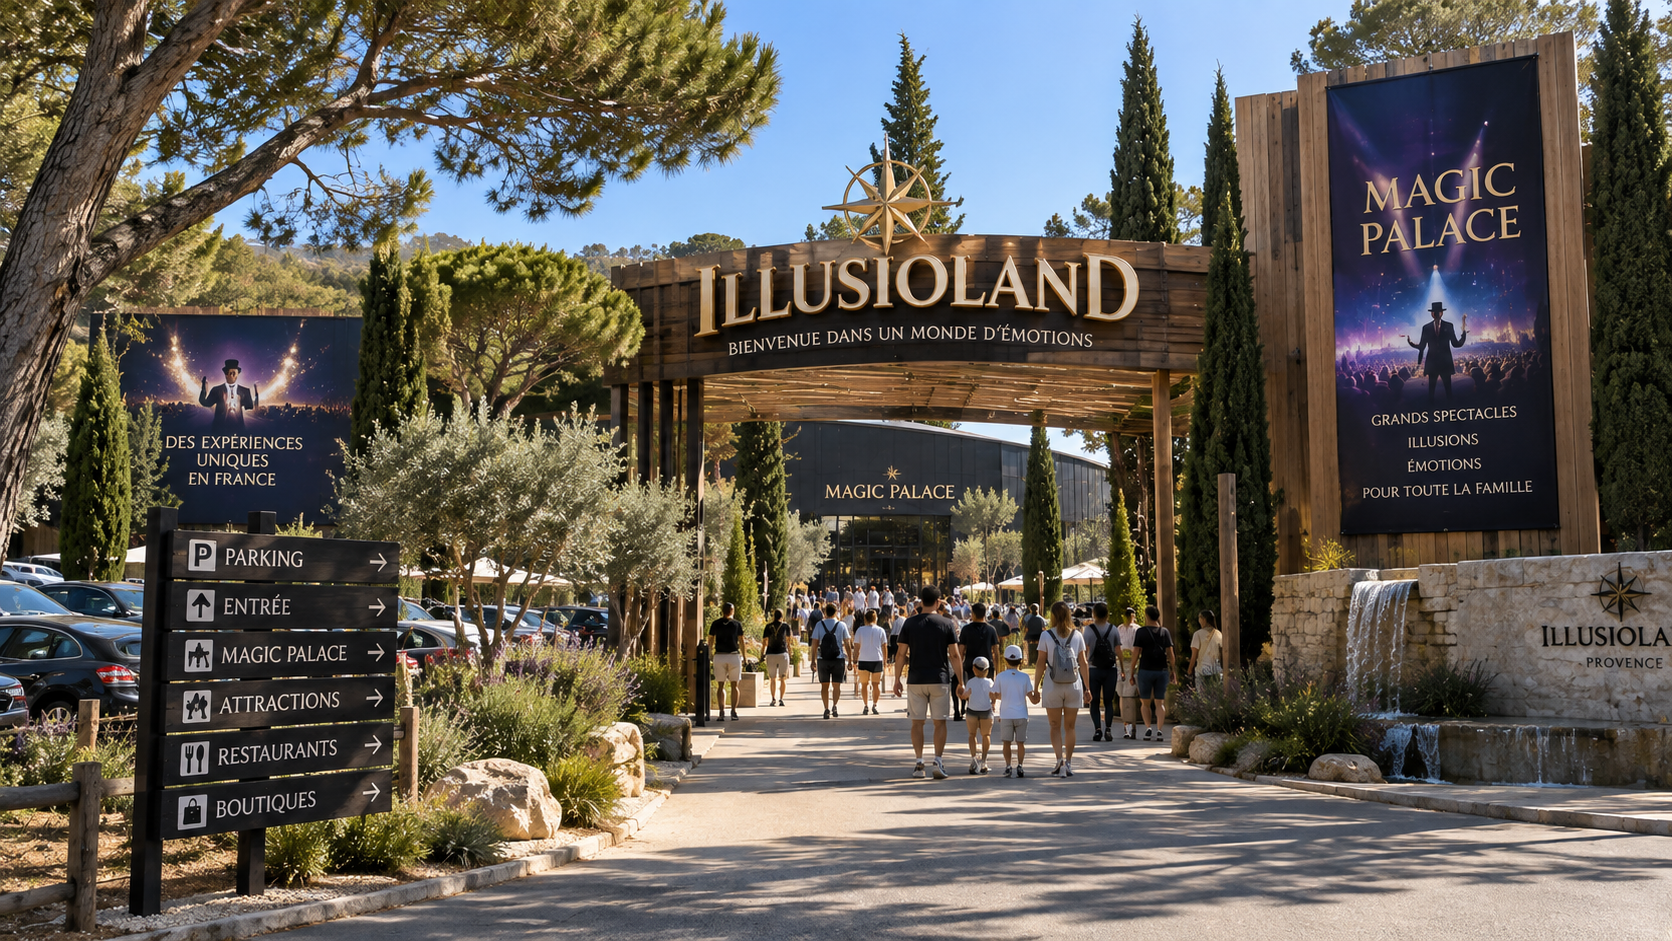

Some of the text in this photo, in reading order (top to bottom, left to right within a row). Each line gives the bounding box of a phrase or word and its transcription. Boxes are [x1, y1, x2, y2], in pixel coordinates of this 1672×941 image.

[1363, 162, 1516, 214] MAGIC
[1360, 205, 1521, 256] PALACE
[694, 252, 1140, 338] ILLUSIOLAND
[728, 331, 821, 356] BIENVENUE
[827, 327, 872, 344] DANS
[878, 326, 904, 341] UN
[910, 325, 977, 341] MONDE
[1371, 405, 1517, 426] GRANDS SPECTACLES
[165, 433, 303, 450] DES EXPÉRIENCES
[1408, 433, 1479, 448] ILLUSIONS
[196, 453, 269, 470] UNIQUES
[1407, 457, 1482, 473] ÉMOTIONS
[188, 472, 276, 487] EN FRANCE
[1362, 480, 1533, 499] POUR TOUTE LA FAMILLE
[824, 484, 955, 499] MAGIC PALACE
[225, 548, 304, 568] PARKING
[223, 594, 291, 615] ENTRÉE
[1541, 625, 1672, 647] ILLUSIOLA
[221, 645, 347, 664] MAGIC PALACE
[1586, 657, 1663, 669] PROVENCE
[219, 691, 340, 715] ATTRACTIONS
[218, 739, 338, 766] RESTAURANTS
[215, 790, 317, 819] BOUTIQUES
